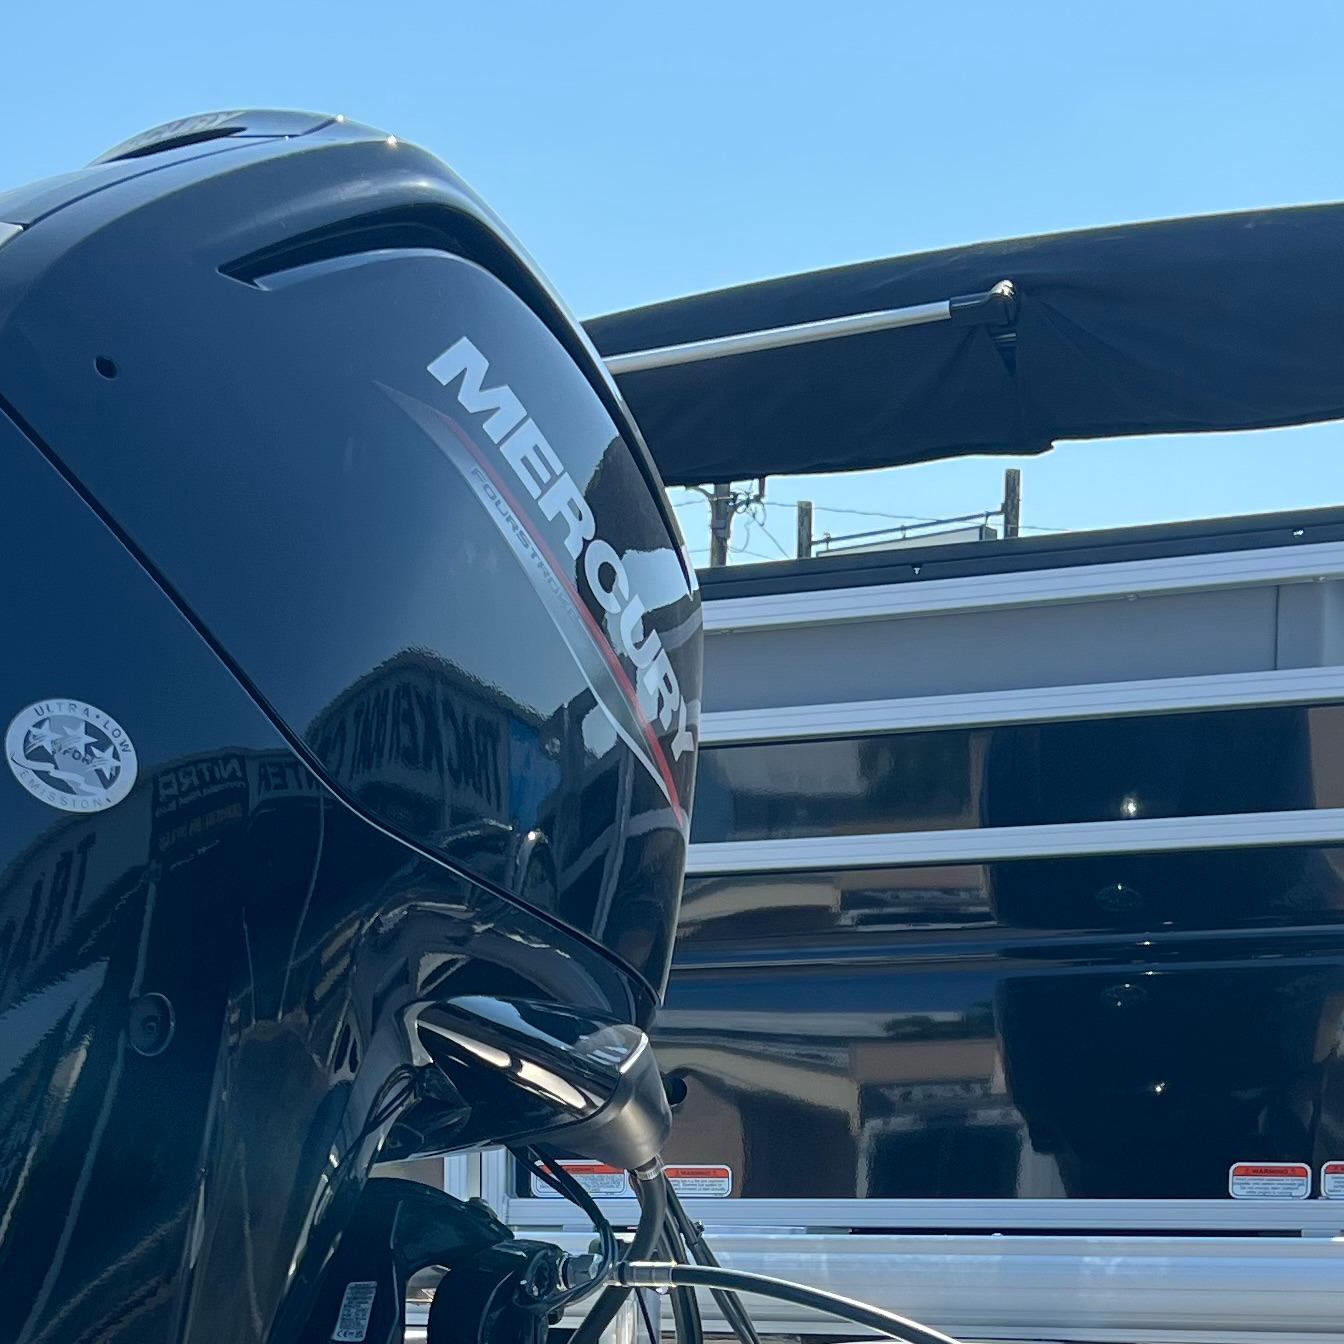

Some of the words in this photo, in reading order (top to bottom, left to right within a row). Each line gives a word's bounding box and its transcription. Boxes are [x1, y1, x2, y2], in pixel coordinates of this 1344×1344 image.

[427, 336, 694, 762] MERCURY
[34, 702, 91, 719] ULTRA
[102, 720, 133, 754] LOW
